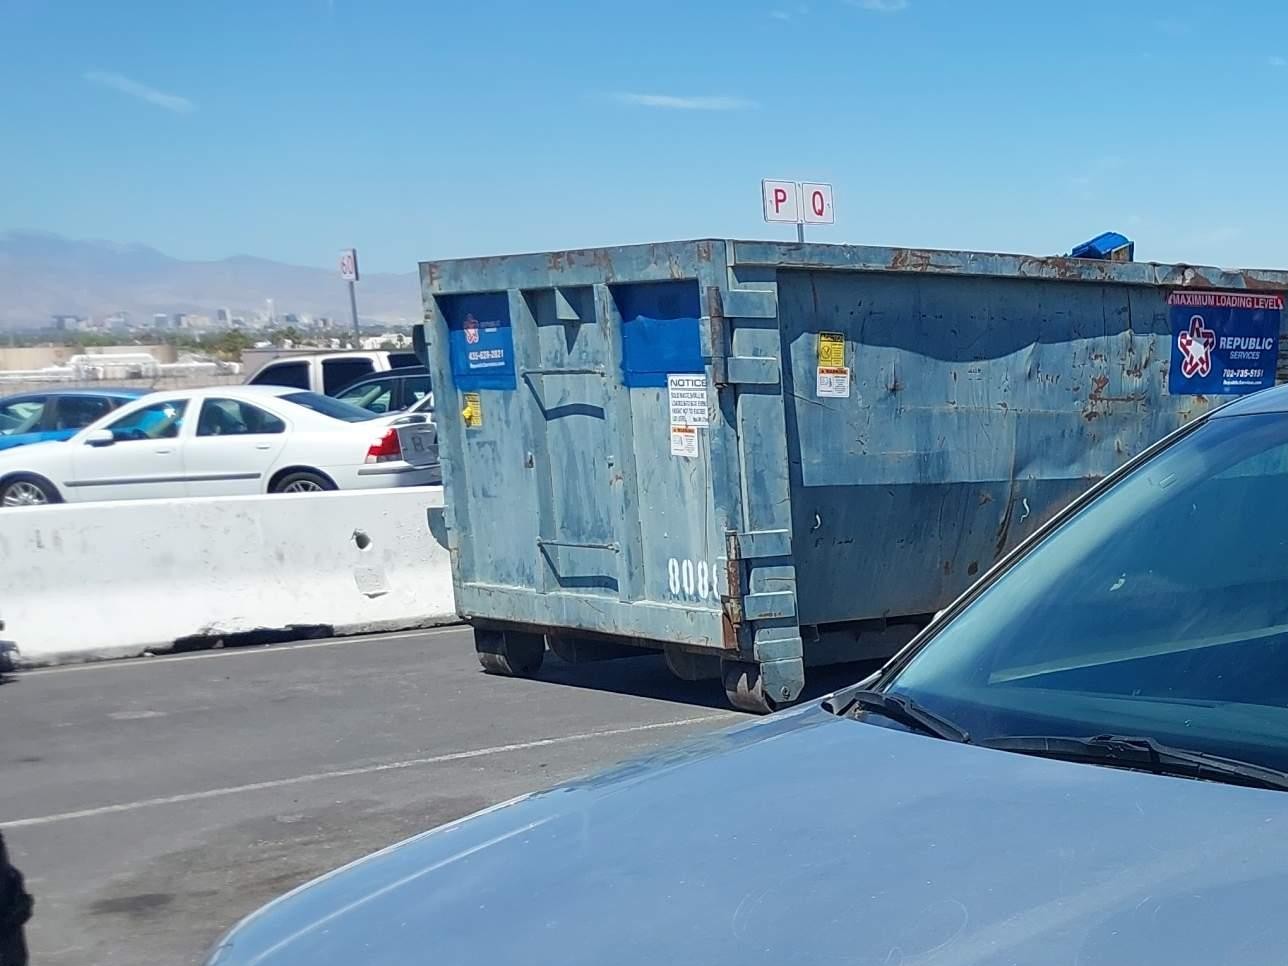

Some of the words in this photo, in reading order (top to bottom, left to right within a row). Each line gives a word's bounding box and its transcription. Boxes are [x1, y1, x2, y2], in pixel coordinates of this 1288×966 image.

[774, 188, 788, 214] P
[811, 190, 825, 217] Q
[1173, 294, 1214, 306] MAXIMUM
[1216, 297, 1252, 308] LOADING
[1253, 299, 1279, 309] LEVEL
[1219, 336, 1274, 350] REPUBLIC
[1230, 351, 1260, 360] SERVICES
[670, 379, 707, 387] NOTICE
